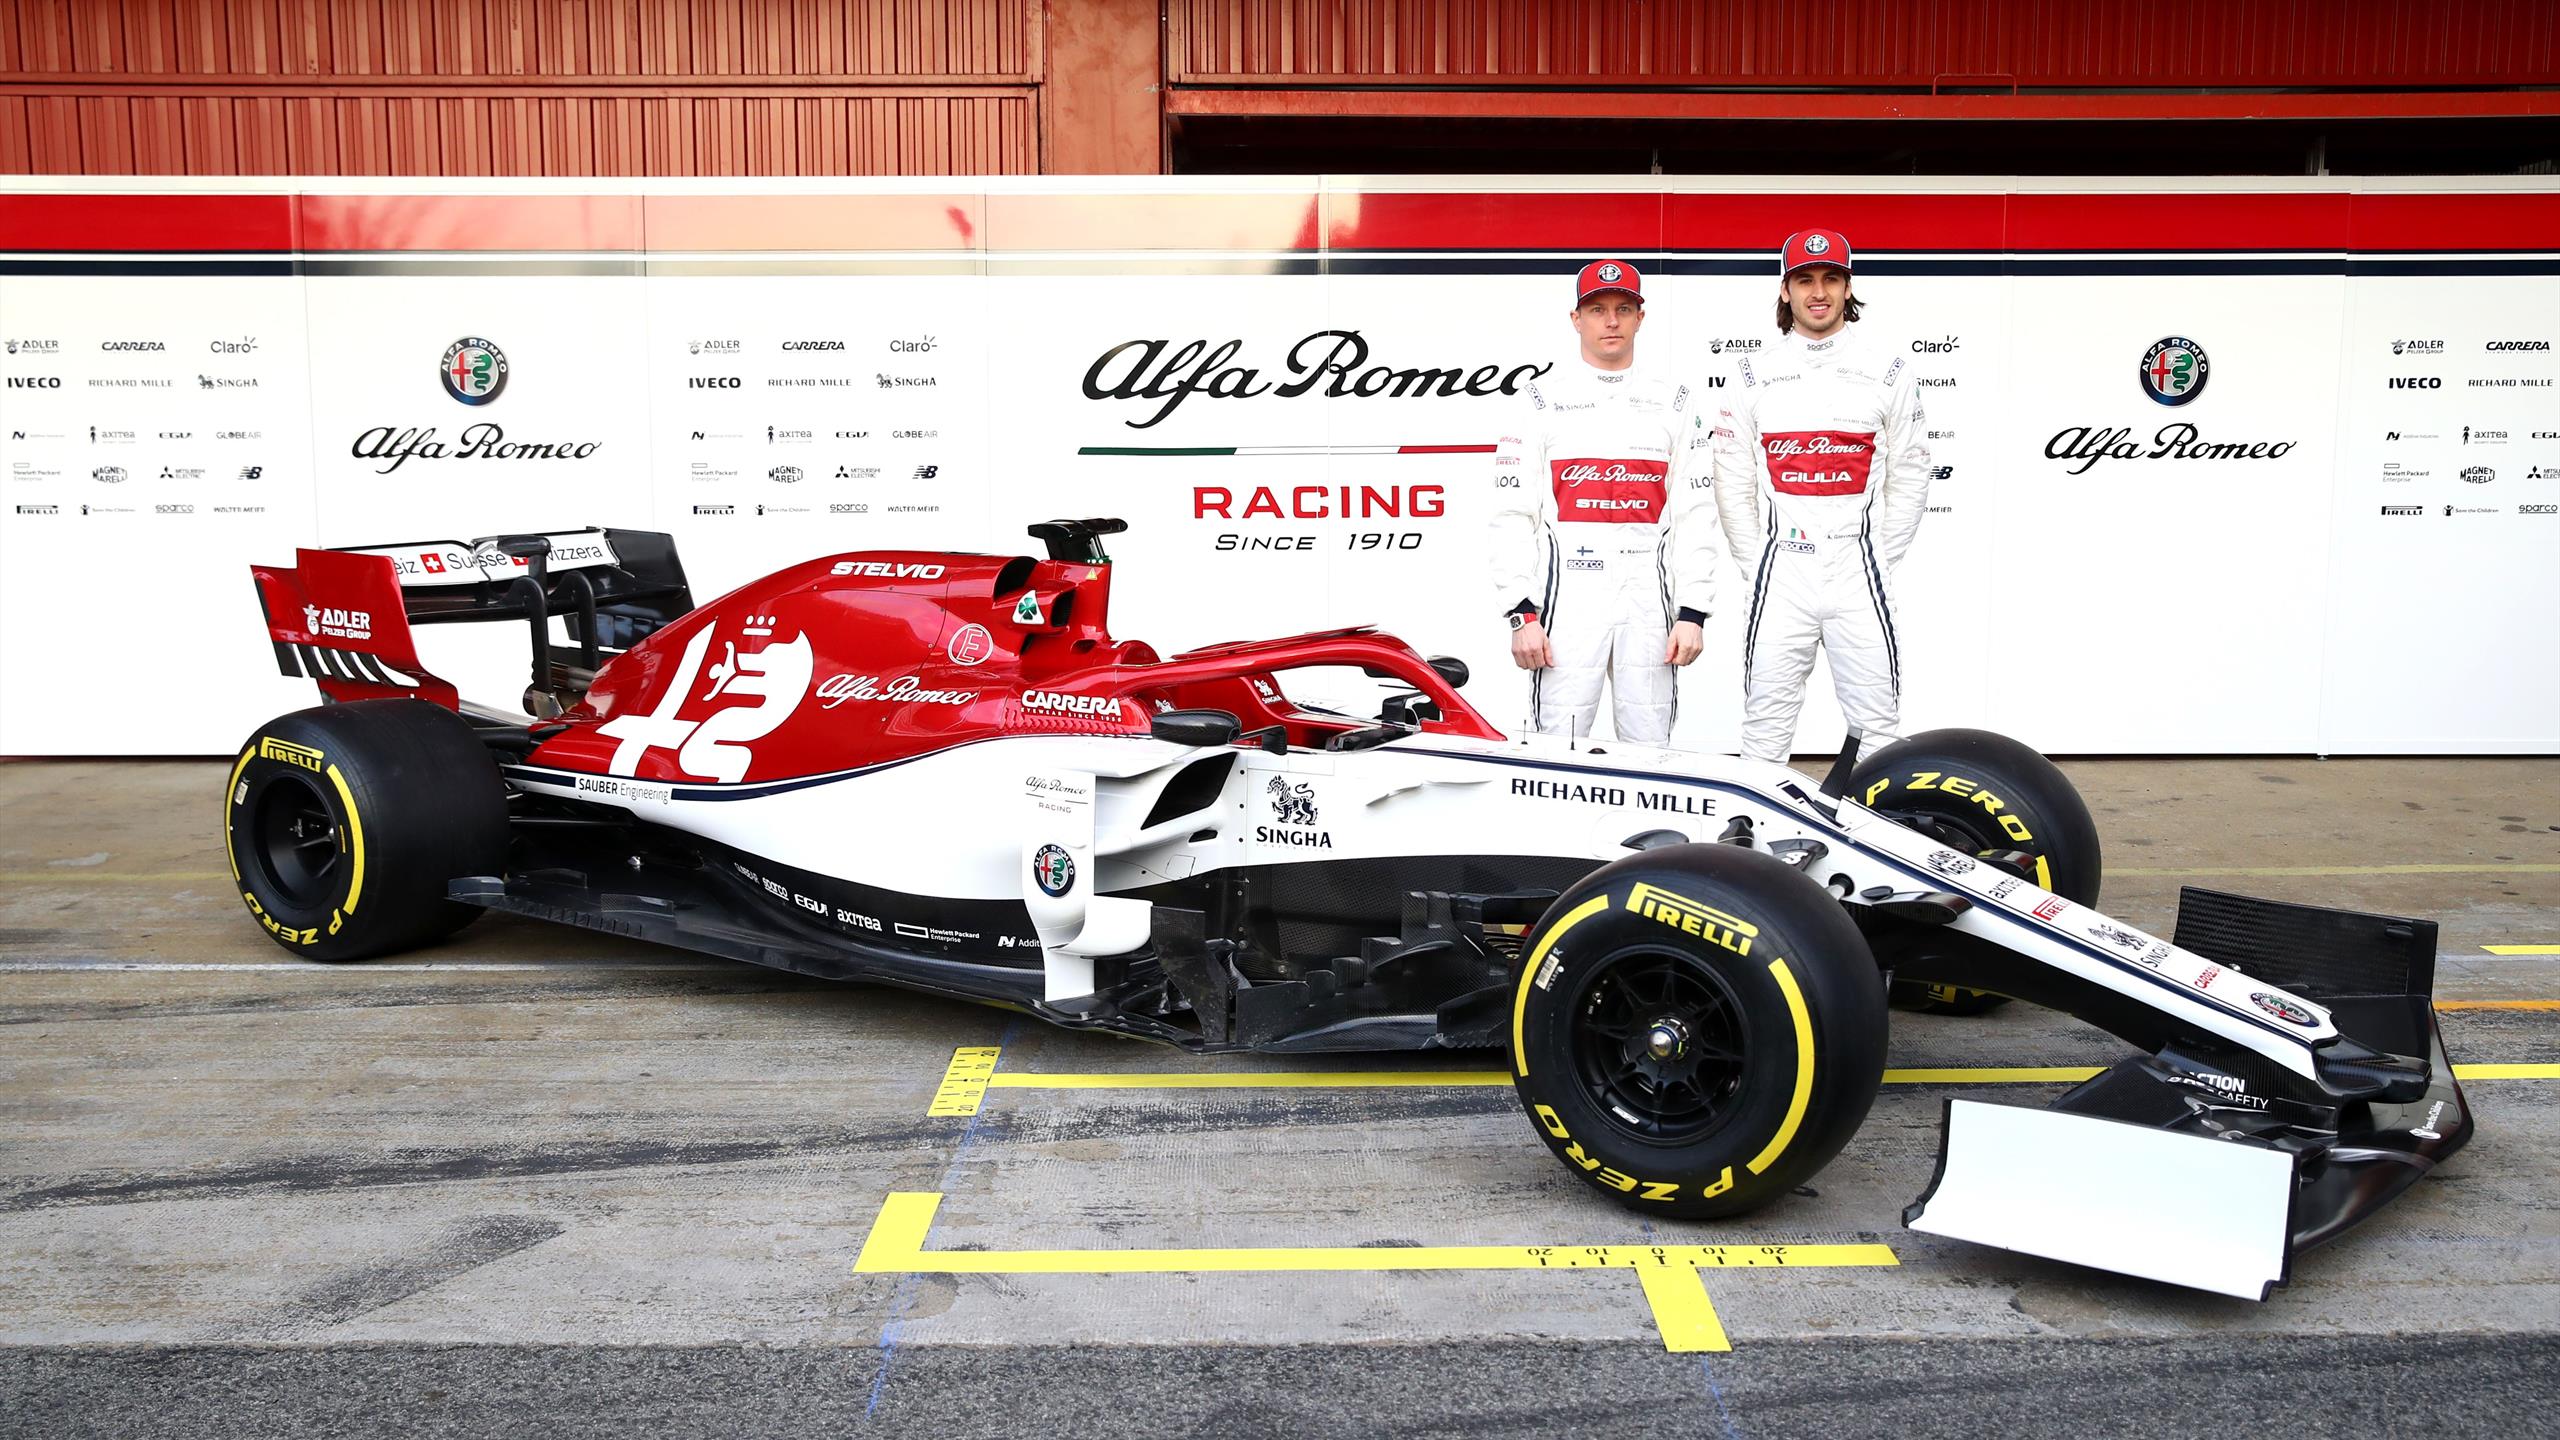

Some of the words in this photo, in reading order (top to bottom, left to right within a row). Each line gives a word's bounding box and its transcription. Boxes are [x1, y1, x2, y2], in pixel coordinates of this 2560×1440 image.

[22, 340, 59, 349] ADLER
[101, 341, 166, 351] CARRERA
[210, 340, 251, 353] Claro
[704, 340, 740, 349] ADLER
[782, 341, 846, 351] CARRERA
[890, 340, 931, 353] Claro
[1726, 339, 1762, 348] ADLER
[1912, 340, 1952, 353] Claro
[2407, 340, 2444, 349] ADLER
[2486, 341, 2550, 351] CARRERA
[7, 377, 61, 389] IVECO
[88, 379, 137, 388] RICHARD
[141, 379, 174, 388] MILLE
[216, 378, 259, 388] SINGHA
[689, 377, 742, 389] IVECO
[768, 379, 816, 387] RICHARD
[820, 379, 852, 387] MILLE
[894, 377, 937, 387] SINGHA
[1082, 339, 1273, 429] Alfa
[1272, 330, 1553, 399] Romeo
[1771, 374, 1801, 383] SINGHA
[2388, 377, 2442, 389] IVECO
[2468, 379, 2517, 387] RICHARD
[2520, 379, 2554, 387] MILLE
[892, 430, 938, 439] GLOBEAIR
[1928, 431, 1955, 439] BEAIR
[351, 426, 453, 475] Alfa
[454, 422, 602, 460] Romeo
[1768, 439, 1807, 461] Alfa
[1808, 436, 1868, 455] Romeo
[2044, 426, 2146, 476] Alfa
[2147, 422, 2298, 460] Romeo
[1561, 465, 1604, 488] Alfa
[1603, 464, 1663, 483] Romeo
[1781, 471, 1852, 483] GIULIA
[830, 503, 868, 513] sparco
[1193, 485, 1445, 519] RACING
[1576, 498, 1649, 510] STELVIO
[16, 505, 59, 515] PIRELLI
[155, 504, 195, 514] sparco
[693, 505, 734, 515] PIRELLI
[2381, 506, 2423, 516] PIRELLI
[2518, 504, 2558, 514] sparco
[1348, 533, 1423, 550] 1910
[447, 553, 507, 569] Susse
[1567, 560, 1603, 569] sparco
[831, 561, 945, 579] STELVIO
[321, 608, 370, 629] ADLER
[321, 626, 346, 637] PELZER
[346, 628, 371, 639] GROUP
[816, 674, 880, 709] Alfa
[878, 676, 977, 706] Romeo
[1021, 689, 1122, 716] CARRERA
[1021, 707, 1062, 716] EYEWEAR
[260, 736, 324, 772] PIRELLI
[1025, 776, 1048, 793] Alfa
[579, 778, 618, 795] SAUBER
[620, 783, 669, 804] Engineering
[1511, 778, 1625, 806] RICHARD
[1636, 791, 1716, 816] MILLE
[1038, 802, 1072, 814] RACING
[1866, 777, 1890, 807] P
[1906, 771, 2033, 842] ZERO
[1256, 825, 1332, 848] SINGHA
[244, 892, 319, 945] ZERO
[328, 908, 343, 936] P
[1625, 881, 1758, 957] PIRELLI
[930, 928, 953, 936] Hewlett
[954, 931, 980, 939] Packard
[1018, 938, 1040, 947] Addit
[1534, 1104, 1680, 1202] ZERO
[1703, 1165, 1734, 1199] P
